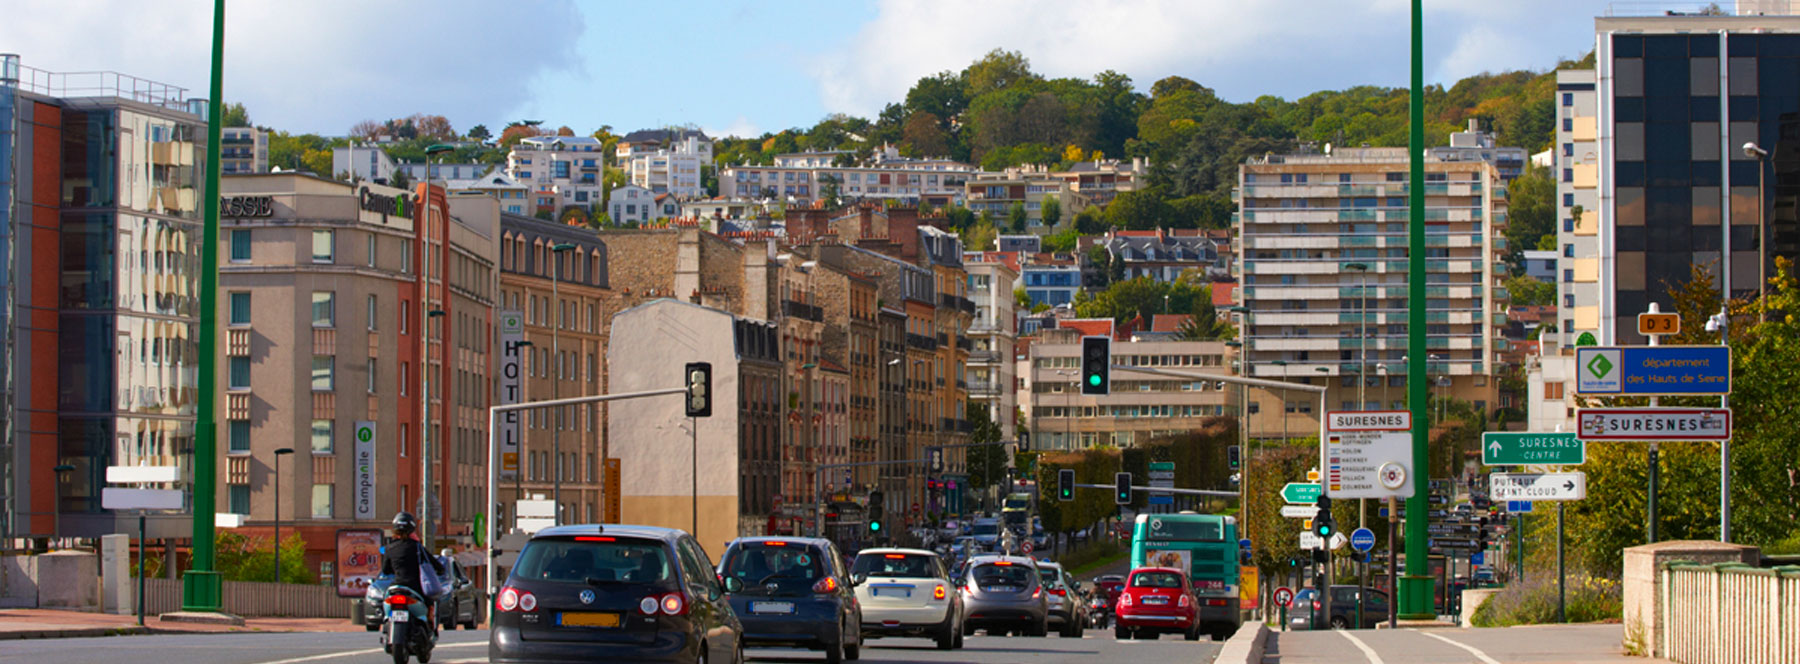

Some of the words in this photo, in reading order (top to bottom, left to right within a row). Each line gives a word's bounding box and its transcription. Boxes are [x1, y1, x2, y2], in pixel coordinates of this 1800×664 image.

[1647, 319, 1656, 331] D
[1664, 319, 1672, 330] 3
[1642, 357, 1710, 369] département
[1626, 374, 1645, 384] des
[1648, 374, 1678, 384] Hauts
[1680, 374, 1695, 384] de
[1698, 373, 1727, 384] Seine
[504, 341, 520, 446] HOTEL
[1336, 416, 1403, 427] SURESNES
[1610, 418, 1698, 431] SURESNES
[1519, 437, 1579, 448] SURESNES
[358, 451, 373, 514] Campanile
[1494, 477, 1536, 486] PUTEAUX
[1495, 487, 1522, 496] SAINT
[1526, 487, 1557, 496] CLOUD
